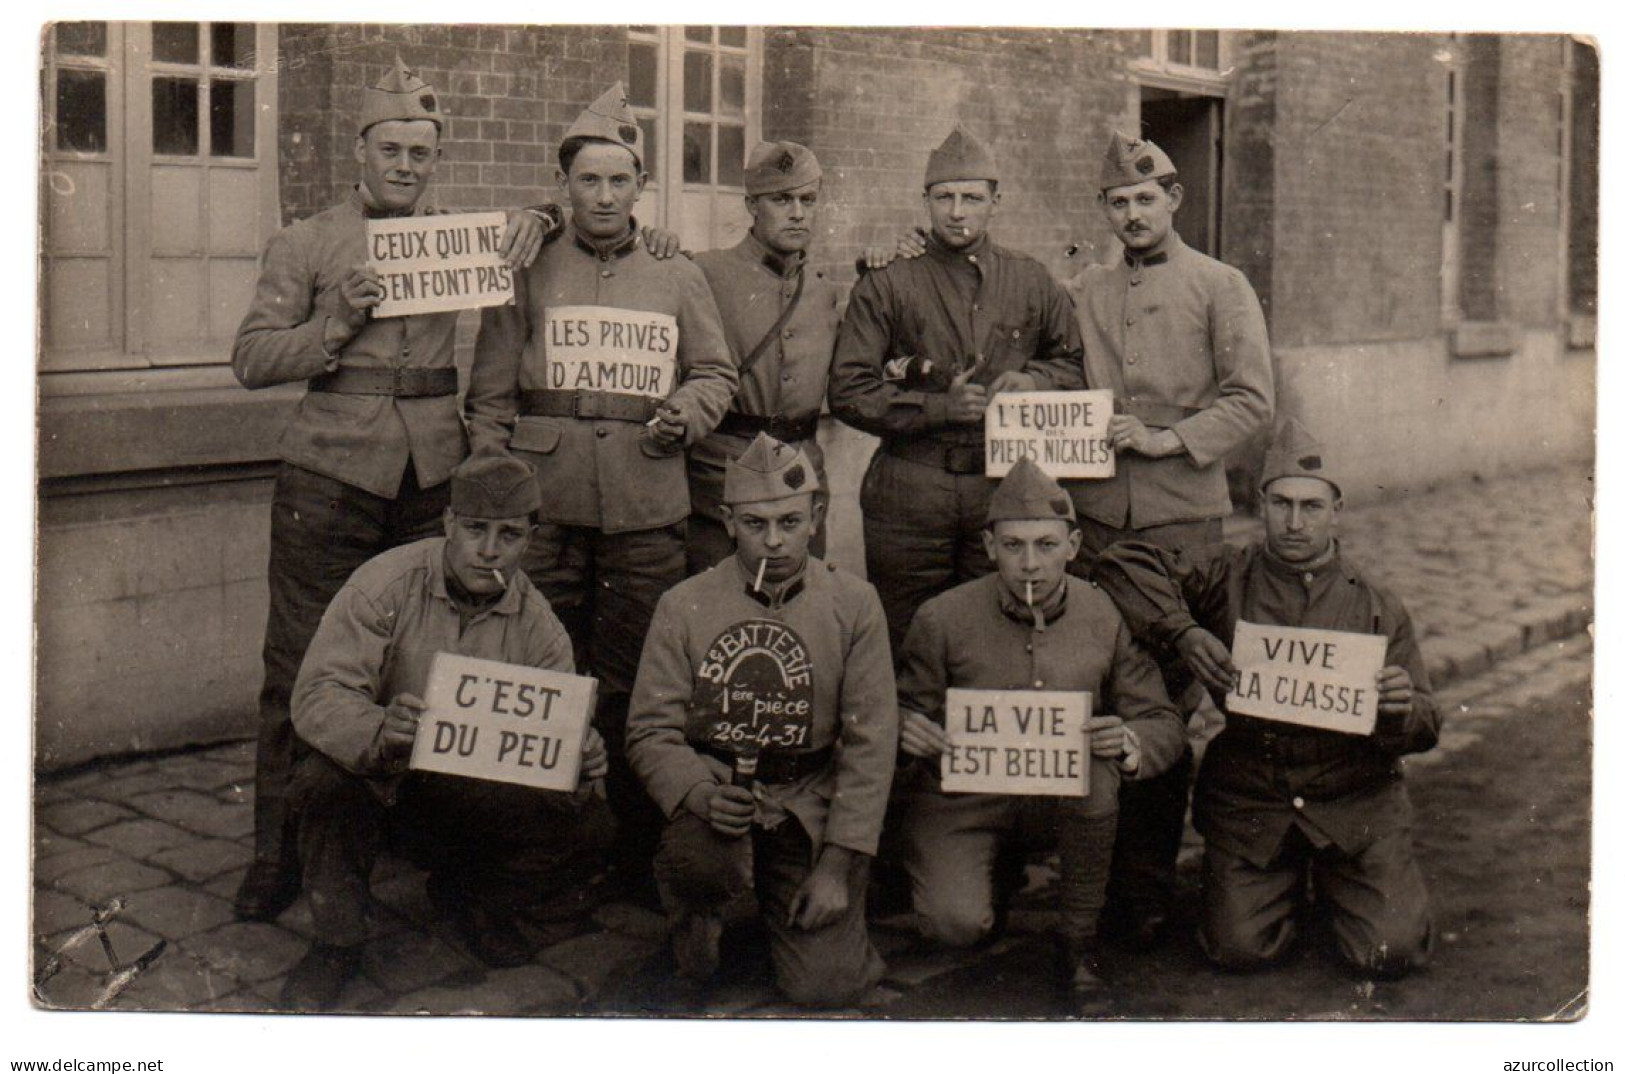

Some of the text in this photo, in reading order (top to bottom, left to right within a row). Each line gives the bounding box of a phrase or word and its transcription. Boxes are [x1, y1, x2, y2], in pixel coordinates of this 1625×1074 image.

[373, 226, 501, 261] CEUX QUI NE
[419, 268, 472, 299] FONT
[475, 265, 512, 294] PAS
[551, 320, 670, 353] LES PRIVÉS
[552, 361, 661, 393] D'AMOUR
[998, 399, 1094, 430] L'ÉQUIPE
[990, 439, 1109, 464] PIEDS NICKLES
[718, 624, 813, 691] BATTERIE
[1262, 637, 1337, 670] VIVE
[455, 674, 561, 721] C'EST
[1233, 669, 1365, 716] LA CLASSE
[752, 692, 810, 728] pièce
[965, 705, 1066, 736] LA VIE
[433, 720, 562, 770] DU PEU
[713, 722, 807, 746] 26-4-31
[950, 745, 1079, 779] EST BELLE
